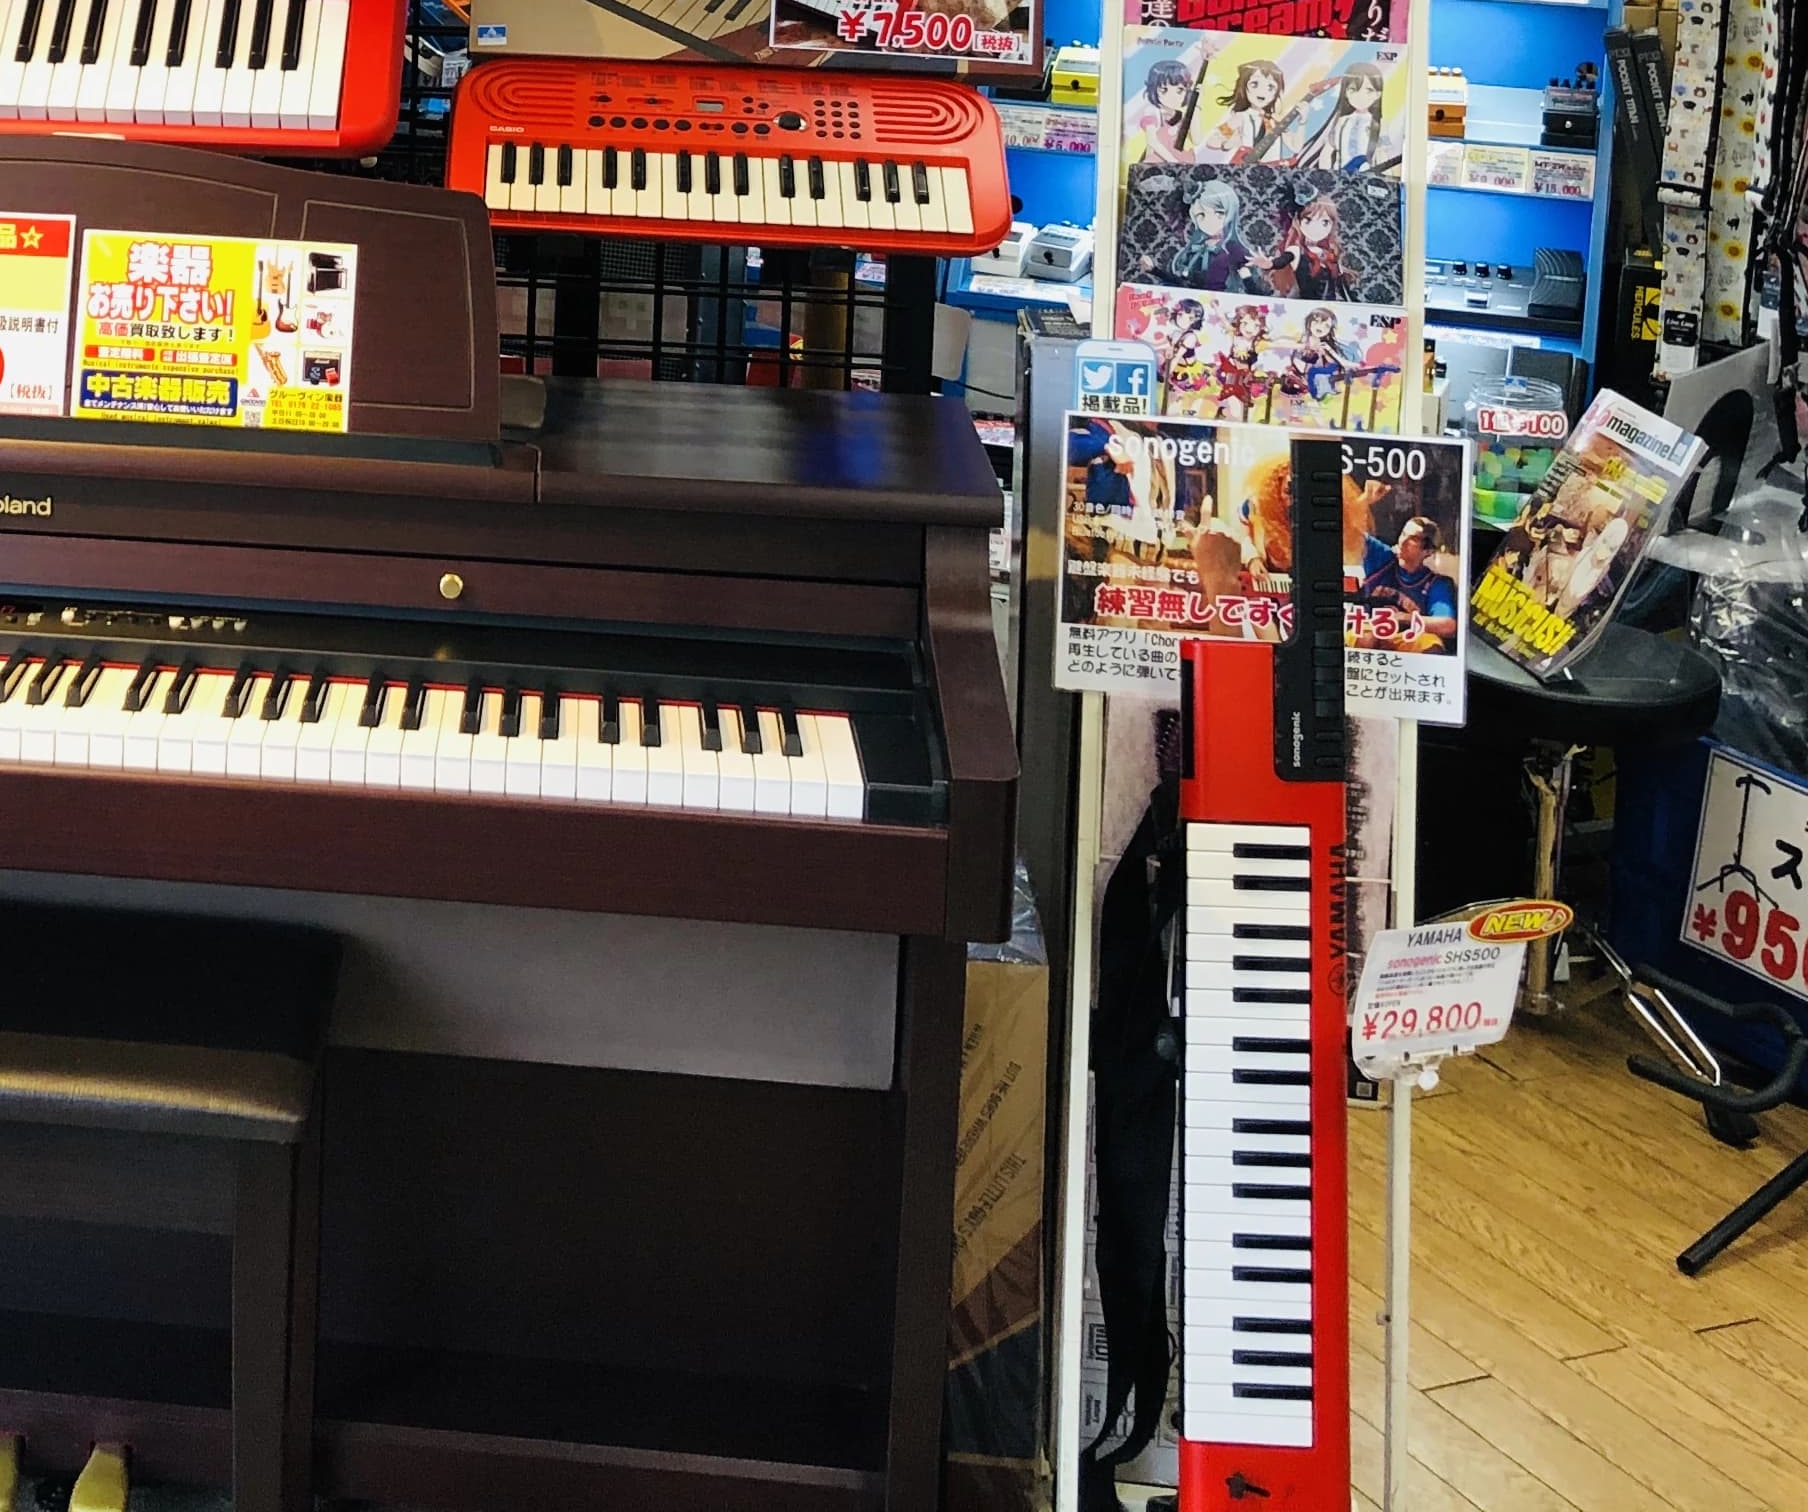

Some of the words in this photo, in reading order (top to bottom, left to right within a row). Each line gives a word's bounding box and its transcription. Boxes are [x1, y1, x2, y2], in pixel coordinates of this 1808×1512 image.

[837, 10, 974, 51] ¥7,500
[127, 241, 213, 288] 楽器
[86, 372, 231, 405] 中古楽器販売
[1080, 395, 1148, 415] 掲載品!
[1107, 433, 1256, 469] sonogenic
[1605, 414, 1672, 461] magazine
[1068, 643, 1178, 663] 再生している曲の
[1067, 662, 1178, 682] どのように弾いて
[1406, 927, 1462, 948] YAMAHA
[1481, 910, 1548, 936] NEW
[1692, 889, 1808, 987] ¥95
[1443, 946, 1501, 966] SHS500
